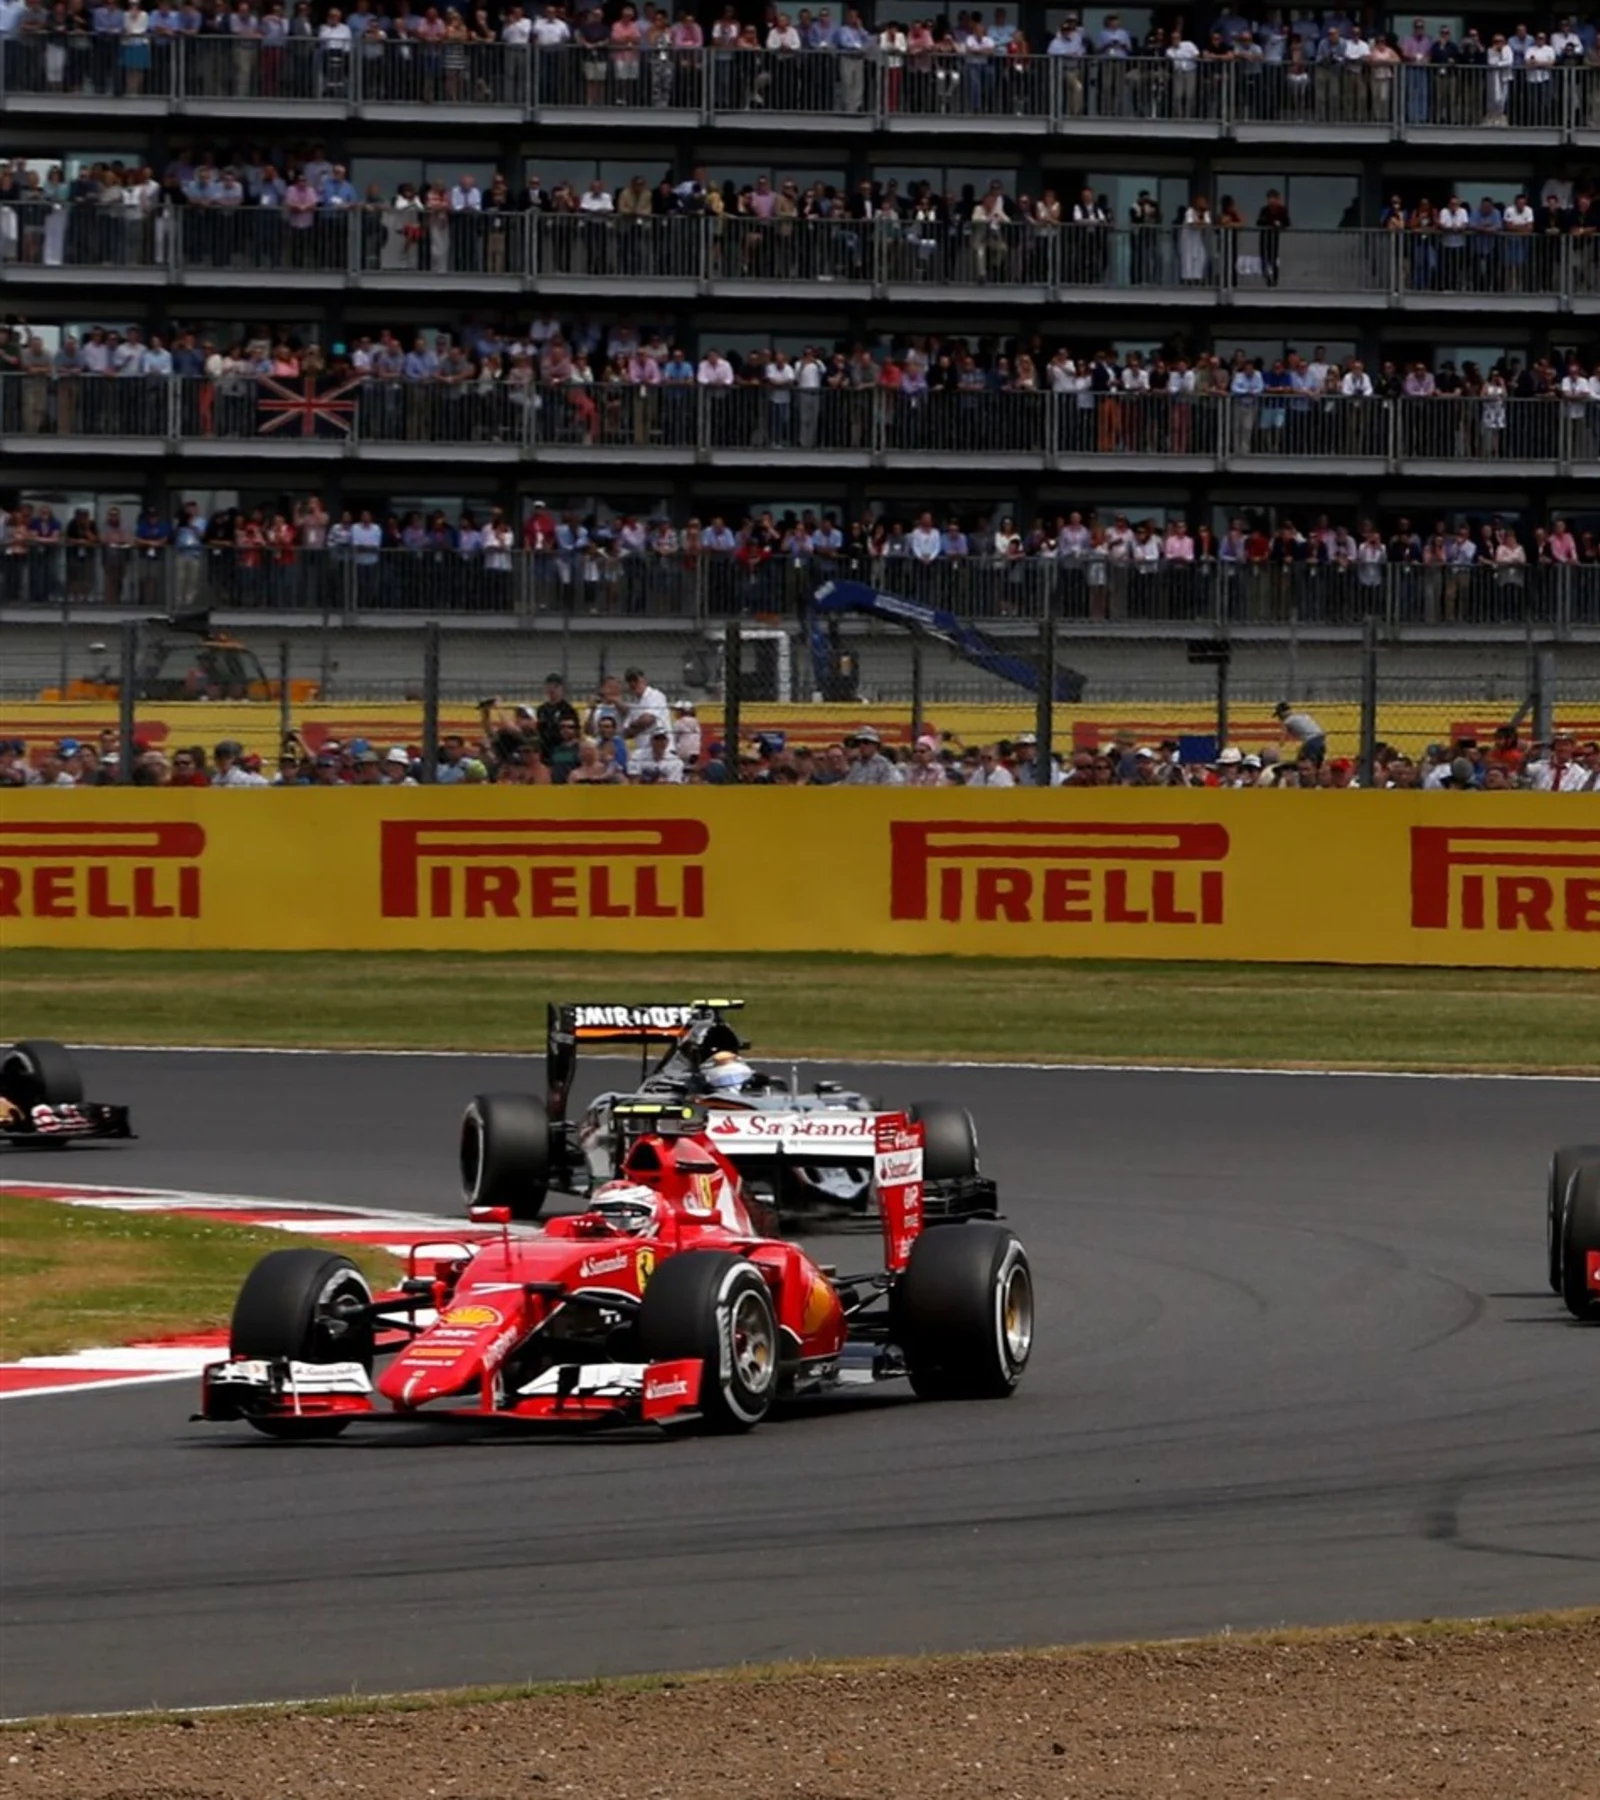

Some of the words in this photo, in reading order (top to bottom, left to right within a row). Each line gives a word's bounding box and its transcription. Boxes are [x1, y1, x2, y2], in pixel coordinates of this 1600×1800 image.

[380, 819, 709, 918] PIRELLI
[890, 820, 1230, 924] PIRELLI
[747, 1115, 876, 1137] Satande
